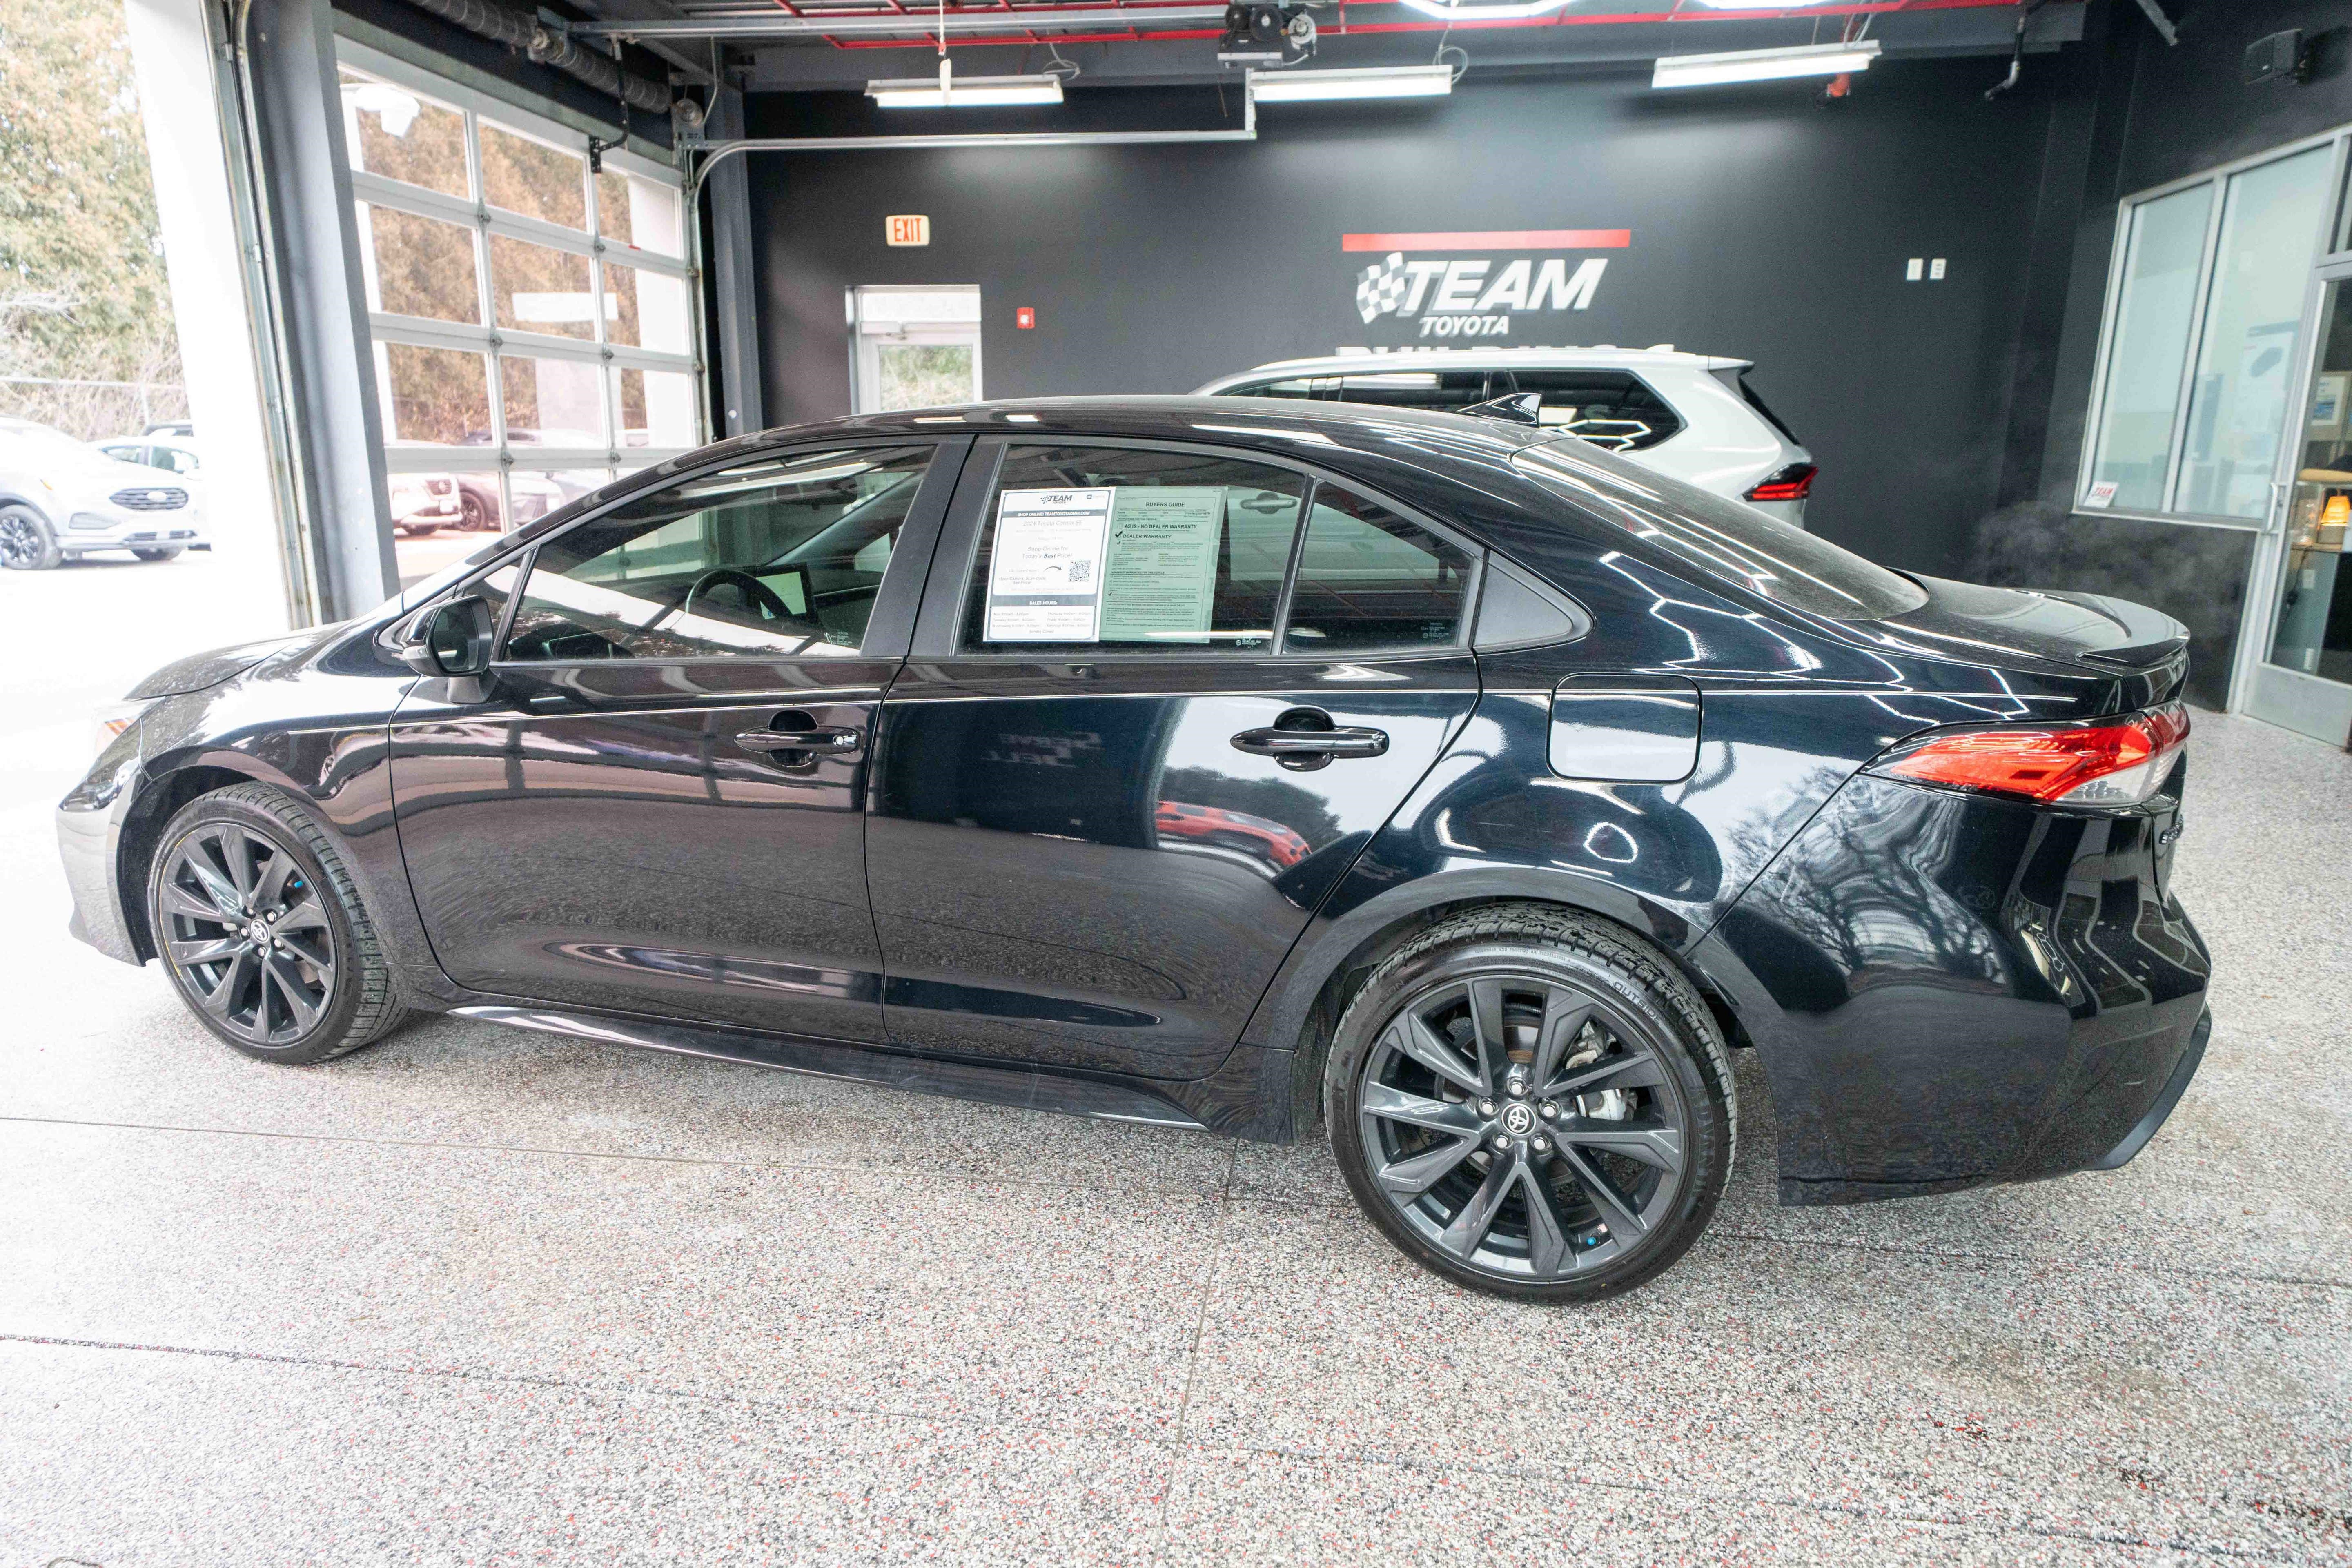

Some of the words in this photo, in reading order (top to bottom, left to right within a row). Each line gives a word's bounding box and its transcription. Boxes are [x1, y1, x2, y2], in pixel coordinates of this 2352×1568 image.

[894, 218, 922, 243] EXIT
[1398, 258, 1608, 315] TEAM
[1419, 316, 1510, 337] TOYOTA
[1613, 981, 1660, 1025] OUTSIDE
